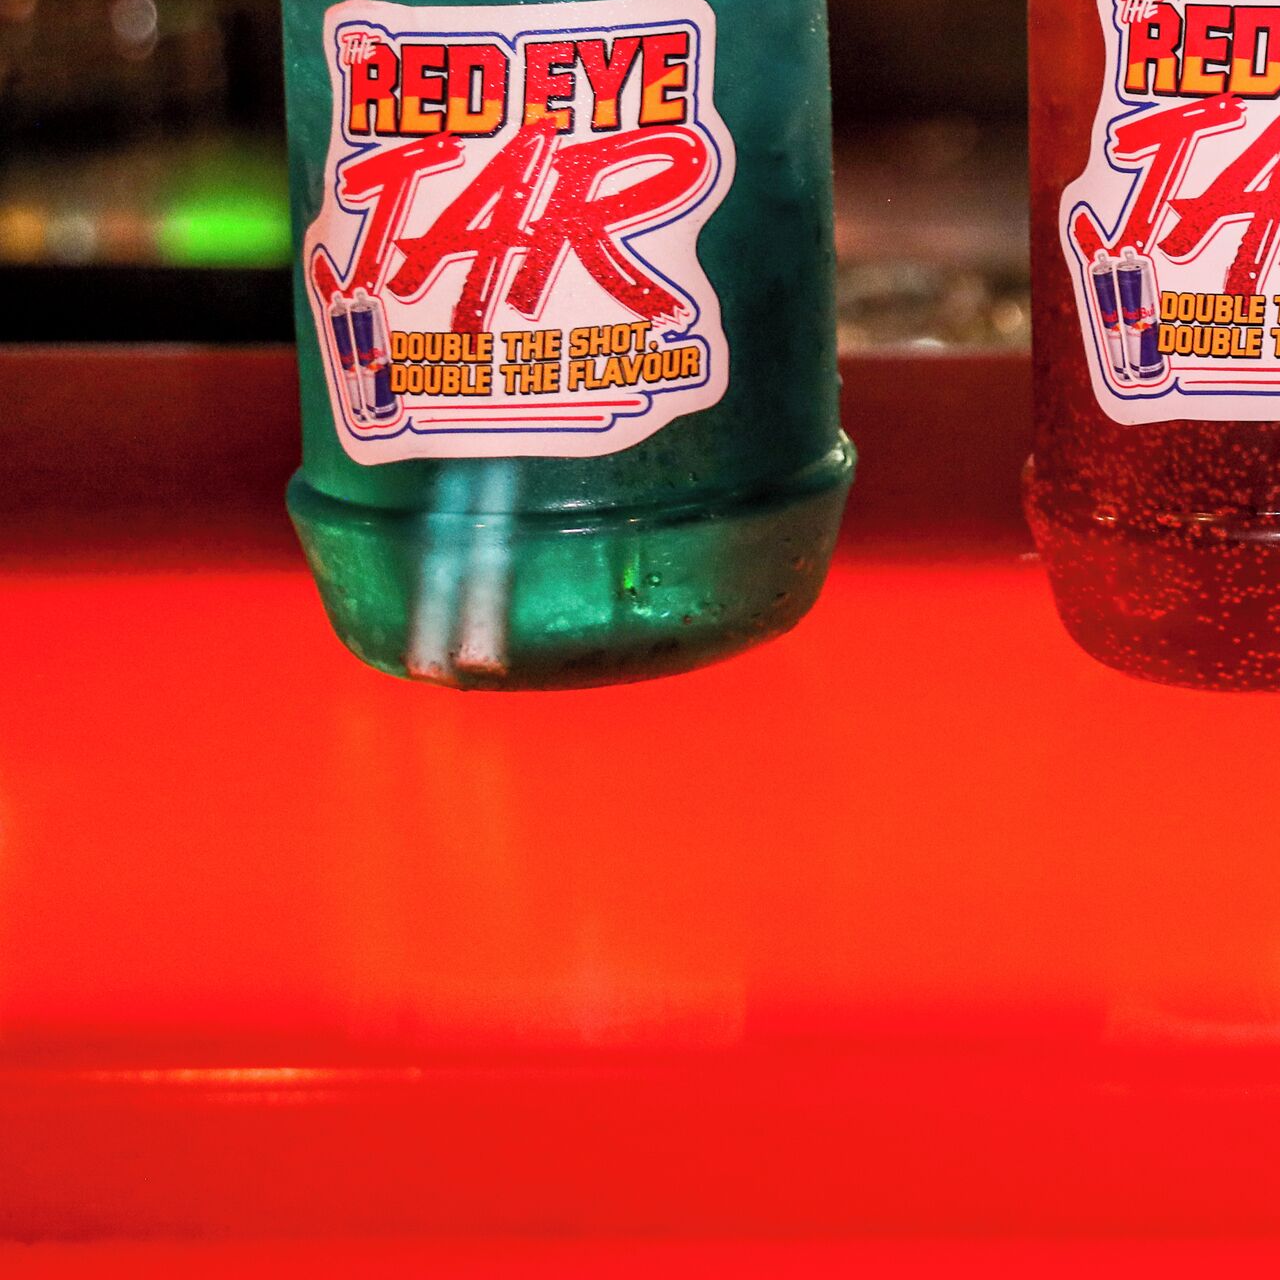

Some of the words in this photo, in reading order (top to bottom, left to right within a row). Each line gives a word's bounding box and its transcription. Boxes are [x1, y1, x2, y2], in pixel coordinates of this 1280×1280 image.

[340, 32, 380, 67] THE
[348, 42, 510, 137] RED
[522, 31, 690, 136] EYE
[312, 117, 711, 335] JAR
[1159, 290, 1266, 325] DOUBLE
[390, 329, 494, 362] DOUBLE
[501, 328, 565, 360] THE
[1157, 324, 1262, 359] DOUBLE
[390, 362, 492, 396] DOUBLE
[500, 361, 564, 394] THE
[567, 347, 701, 391] FLAVOUR
